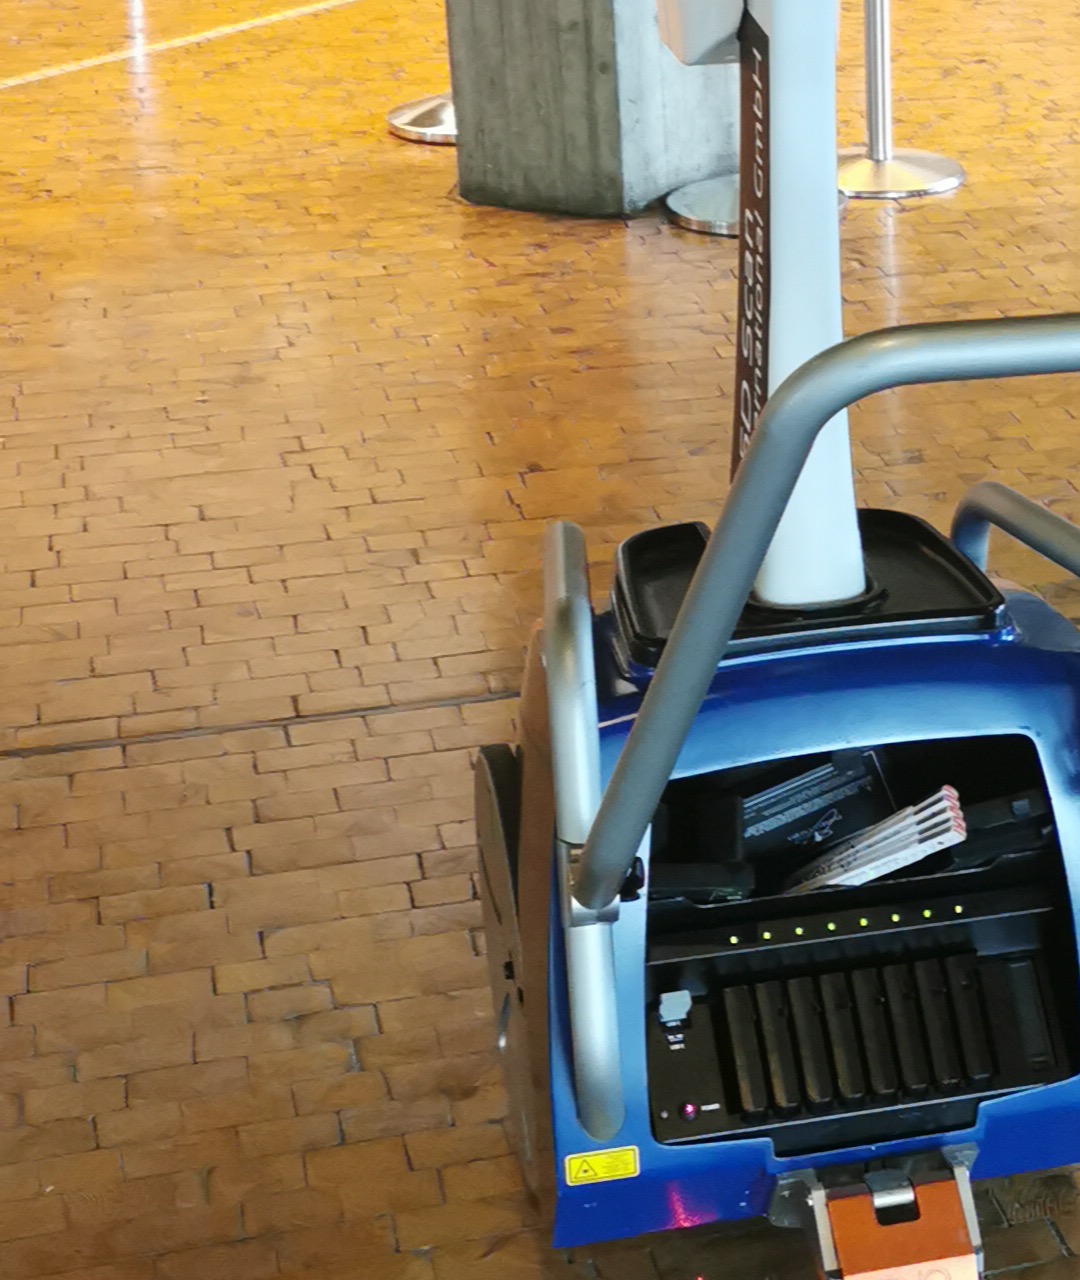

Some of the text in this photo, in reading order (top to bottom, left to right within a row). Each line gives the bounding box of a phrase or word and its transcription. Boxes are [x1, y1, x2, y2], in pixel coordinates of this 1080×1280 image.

[741, 208, 753, 366] Scan
[751, 46, 764, 422] rnational GmbH
